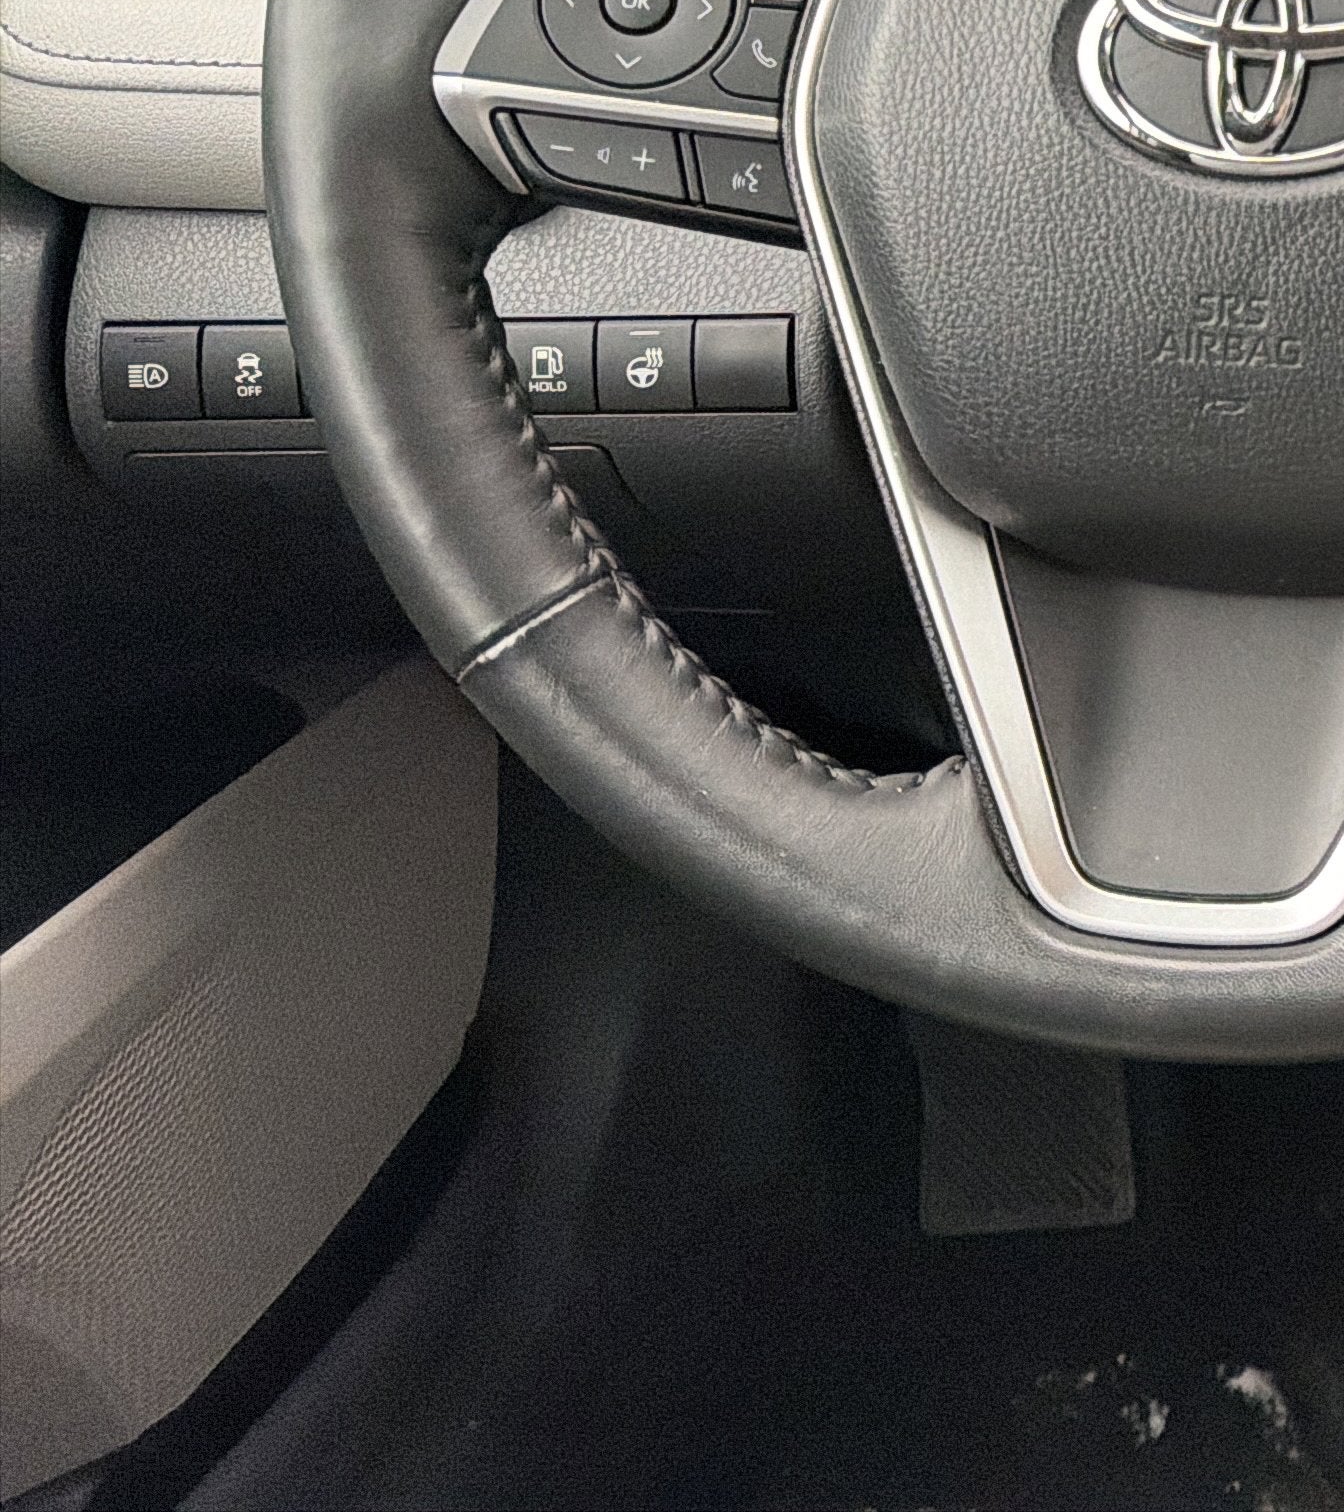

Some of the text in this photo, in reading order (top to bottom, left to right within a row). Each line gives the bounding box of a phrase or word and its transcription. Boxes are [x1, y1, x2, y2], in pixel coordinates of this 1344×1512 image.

[1197, 295, 1270, 329] SRS
[1152, 335, 1303, 370] AIRBAG
[237, 386, 262, 397] OFF
[529, 381, 567, 392] HOLD
